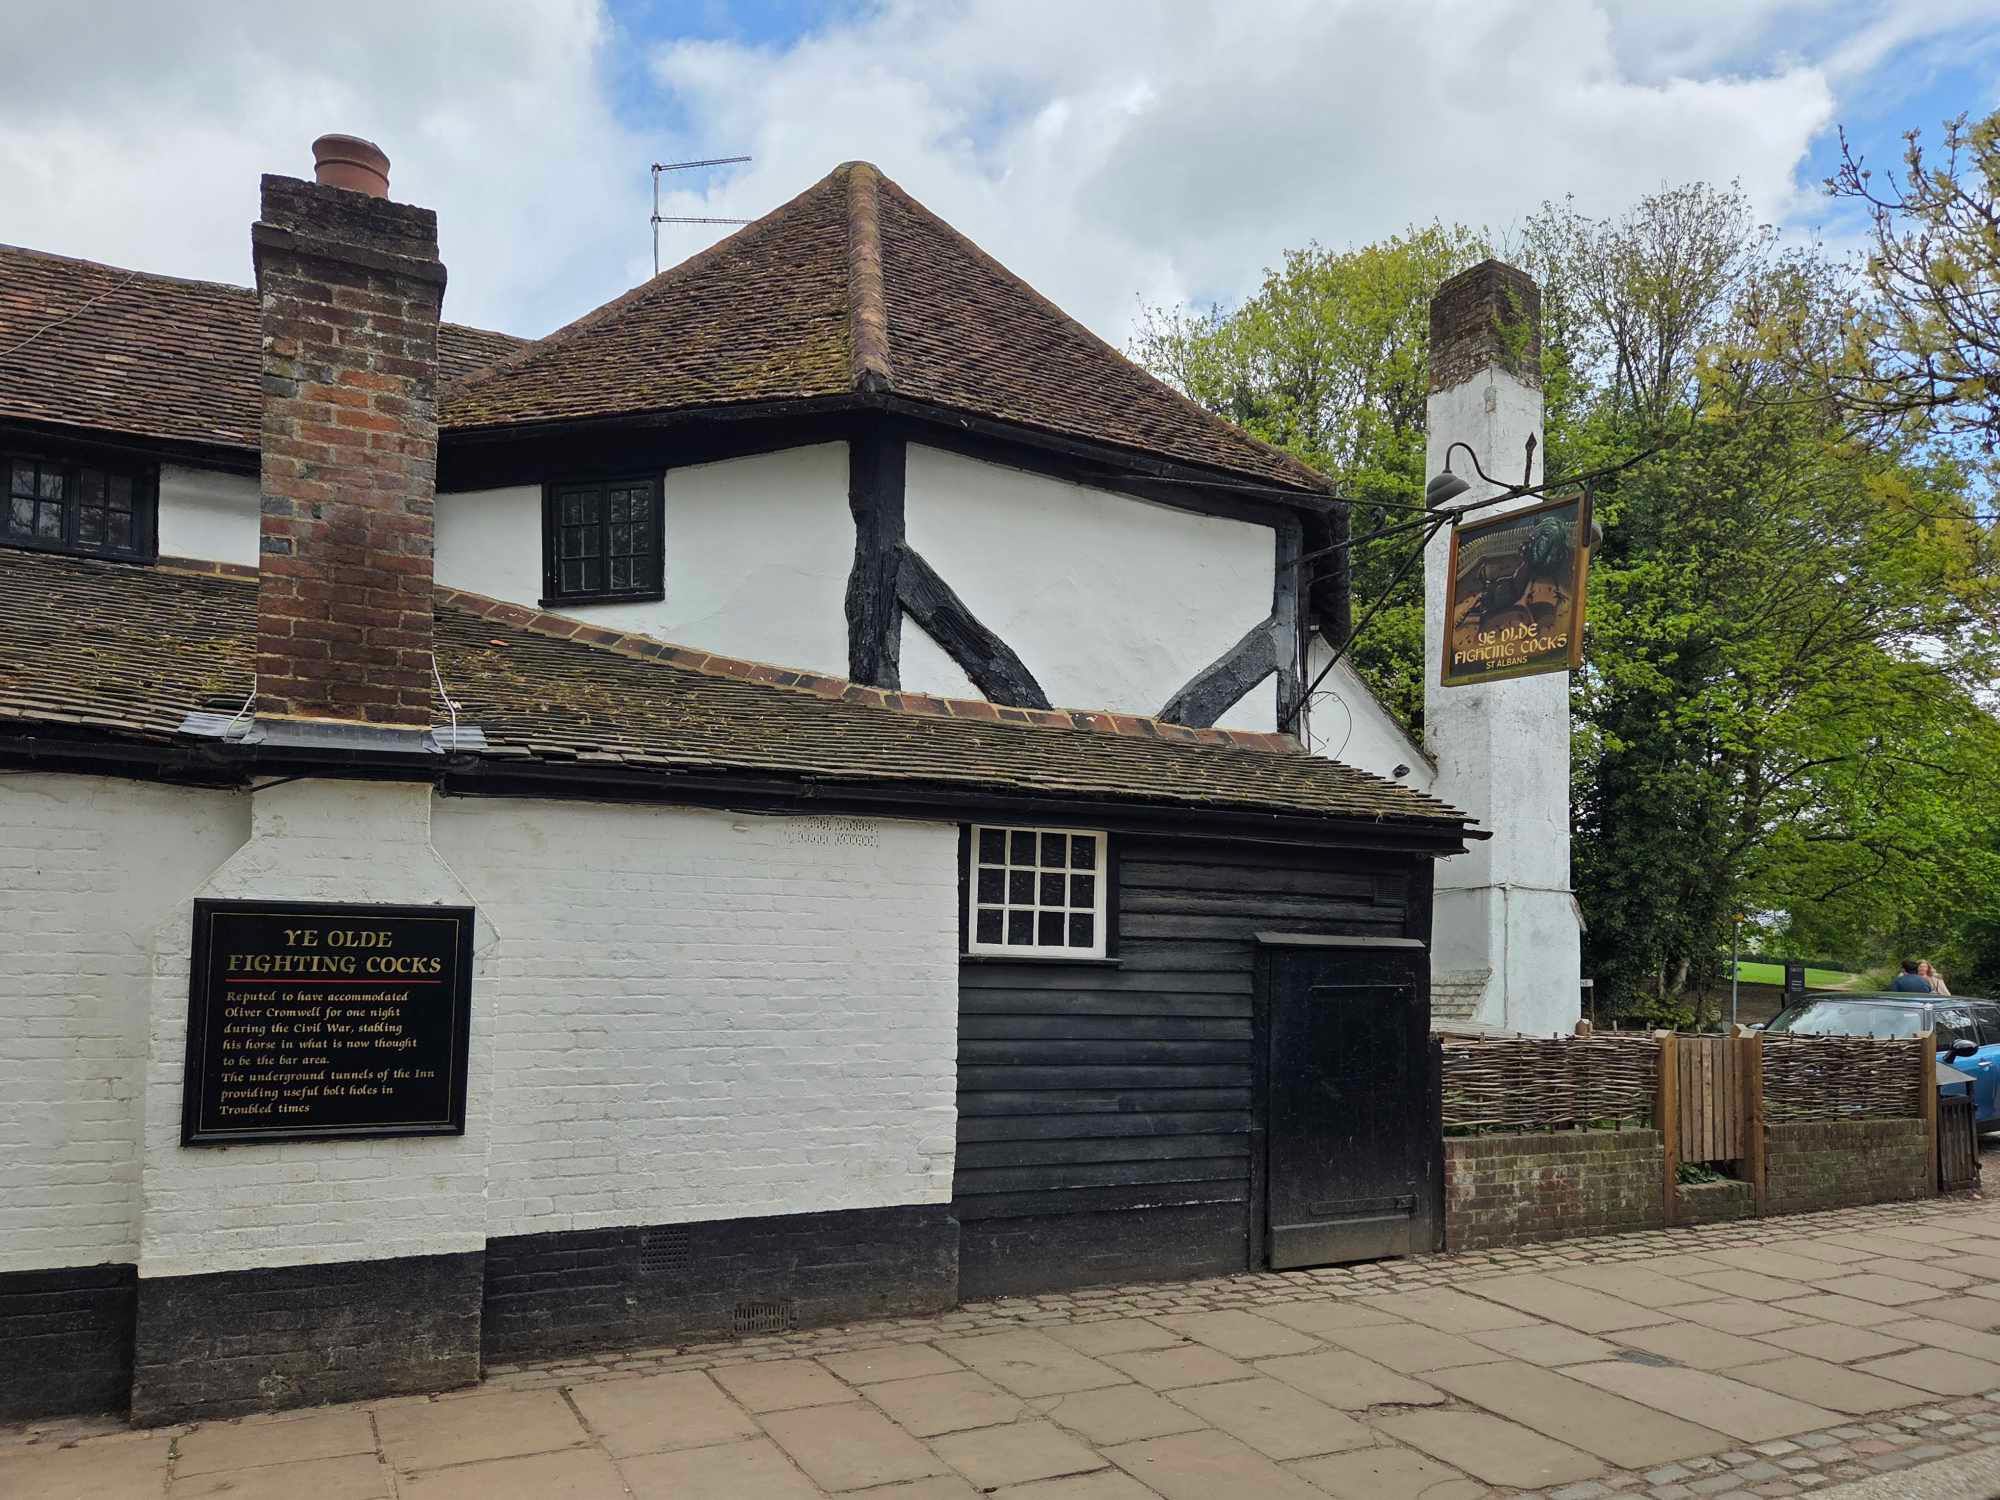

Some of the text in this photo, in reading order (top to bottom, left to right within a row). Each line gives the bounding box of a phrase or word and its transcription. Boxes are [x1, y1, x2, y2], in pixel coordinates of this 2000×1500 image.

[1478, 622, 1538, 645] YE OLDE
[1455, 633, 1568, 664] FIGHTING COCKS
[1486, 656, 1527, 670] ST ALBANS
[283, 930, 393, 948] YE OLDE
[227, 954, 441, 973] FIGHTING COCKS
[227, 991, 409, 1004] Reputed to have accommodated
[225, 1007, 401, 1020] Oliver Cromwell for one night
[224, 1023, 402, 1036] during the Civil War, stabling
[223, 1039, 417, 1051] his horse in what is now thought
[223, 1057, 234, 1065] to
[239, 1056, 250, 1065] be
[257, 1056, 274, 1065] the
[279, 1056, 297, 1065] bar
[222, 1069, 435, 1085] The underground tunnels of the Inn
[221, 1085, 393, 1102] providing useful bolt holes in
[219, 1104, 310, 1115] Troubled times
